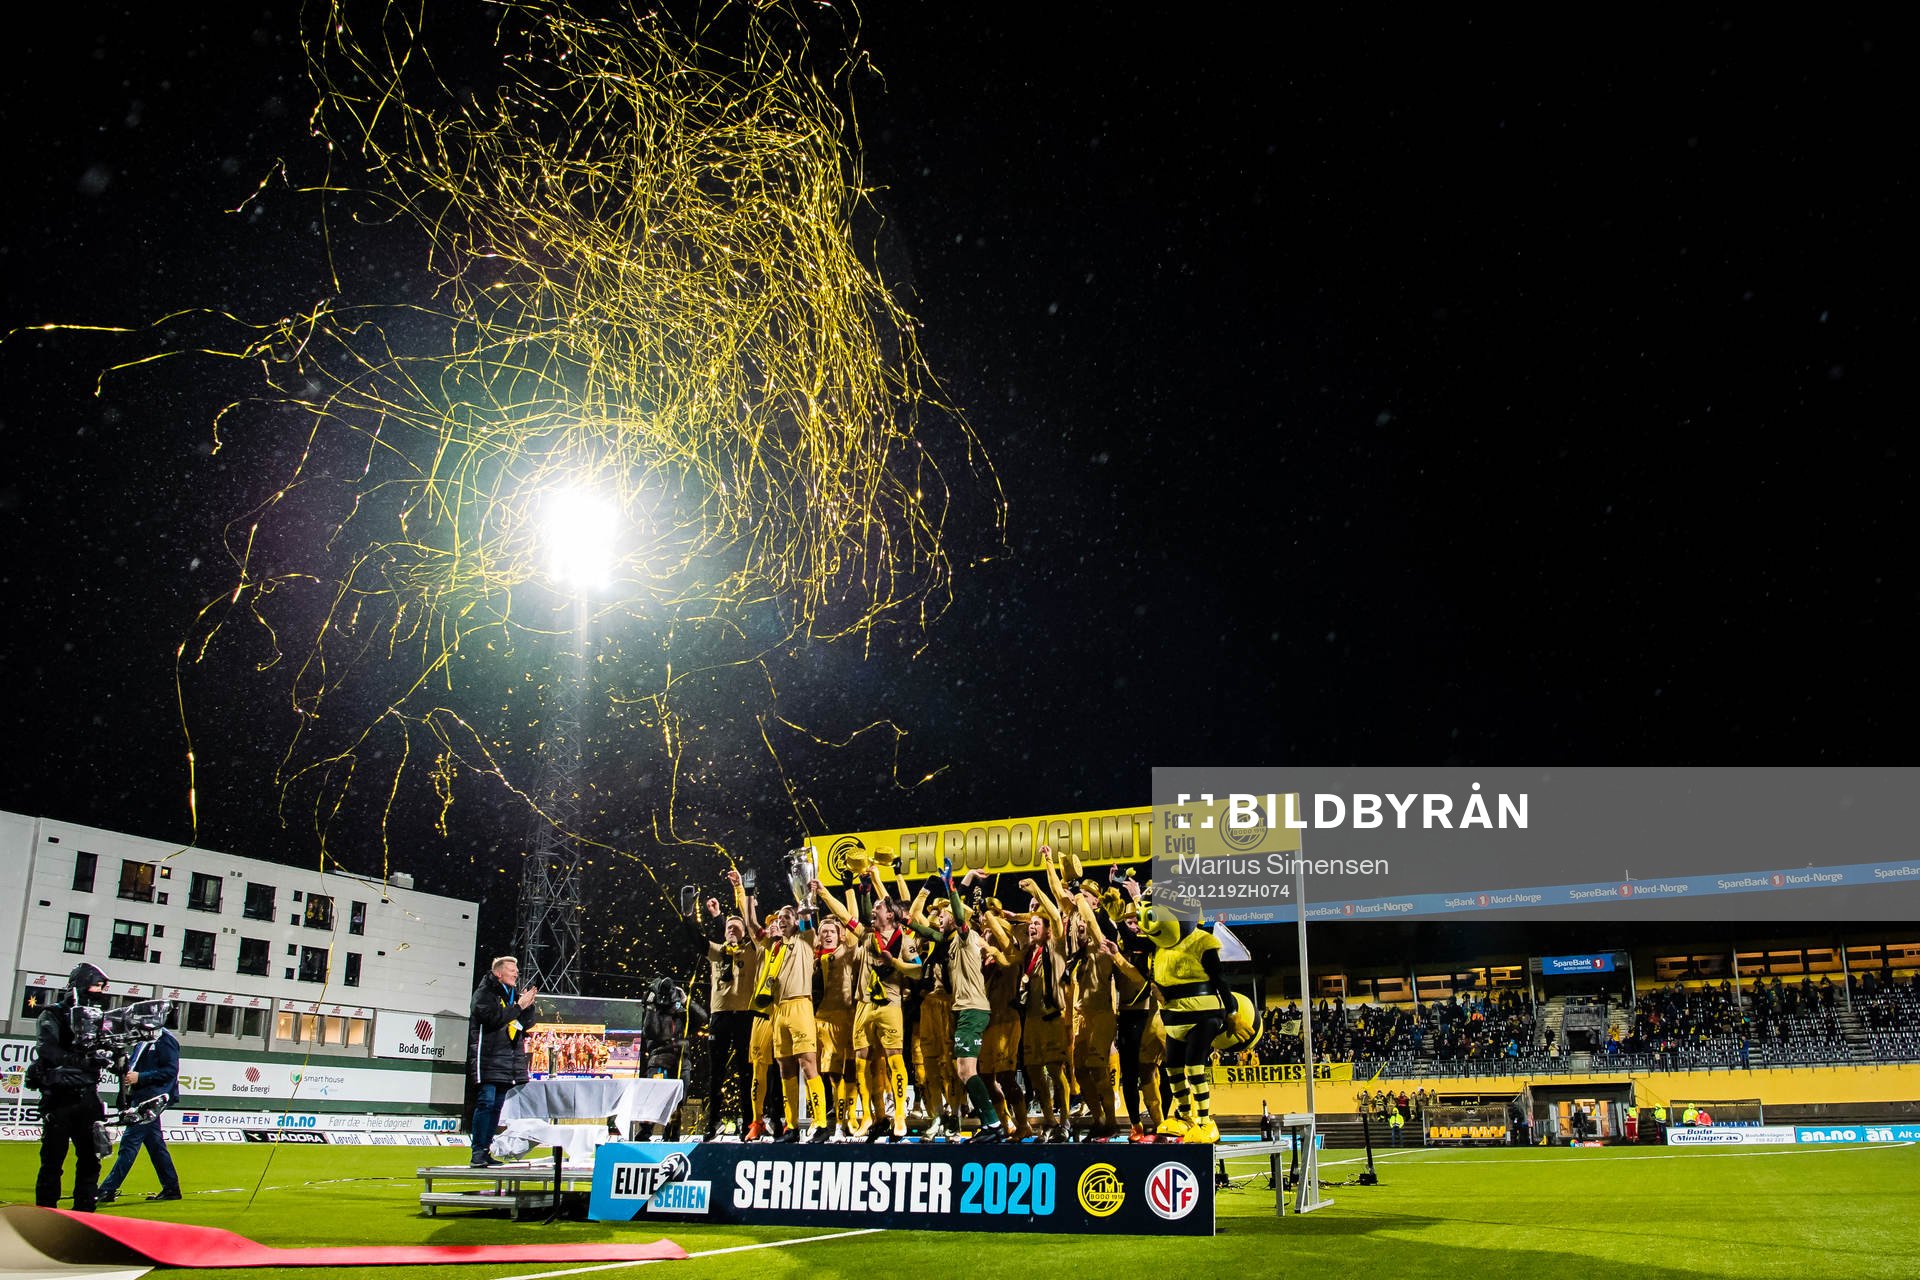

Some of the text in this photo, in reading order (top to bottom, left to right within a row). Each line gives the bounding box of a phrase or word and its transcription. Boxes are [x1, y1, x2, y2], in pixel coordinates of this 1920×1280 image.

[1165, 834, 1196, 855] Evig
[900, 831, 940, 875] FK
[1717, 876, 1768, 889] SpareBank
[1786, 872, 1843, 884] Nord-Norge
[1569, 887, 1618, 899] SpareBank
[1634, 883, 1688, 895] Nord-Norge
[1490, 893, 1542, 904] Nord-Norge
[1355, 902, 1413, 913] Nord-Norge
[1228, 911, 1274, 921] Nord-Norge
[1553, 958, 1591, 968] SpareBank
[399, 1043, 446, 1058] Bodø Energi
[303, 1075, 345, 1084] smart house
[1227, 1065, 1331, 1083] SERIEMESER
[232, 1084, 270, 1095] Bodø Energi
[204, 1115, 271, 1125] TORGHATTEN
[276, 1115, 316, 1128] an.no
[423, 1119, 457, 1131] an.no
[267, 1133, 324, 1143] DIADORA
[1801, 1128, 1856, 1141] an.no
[1898, 1130, 1913, 1139] Alt
[614, 1167, 660, 1195] ELITE
[733, 1160, 1057, 1216] SERIEMESTER 2020
[654, 1185, 706, 1209] SERIEN
